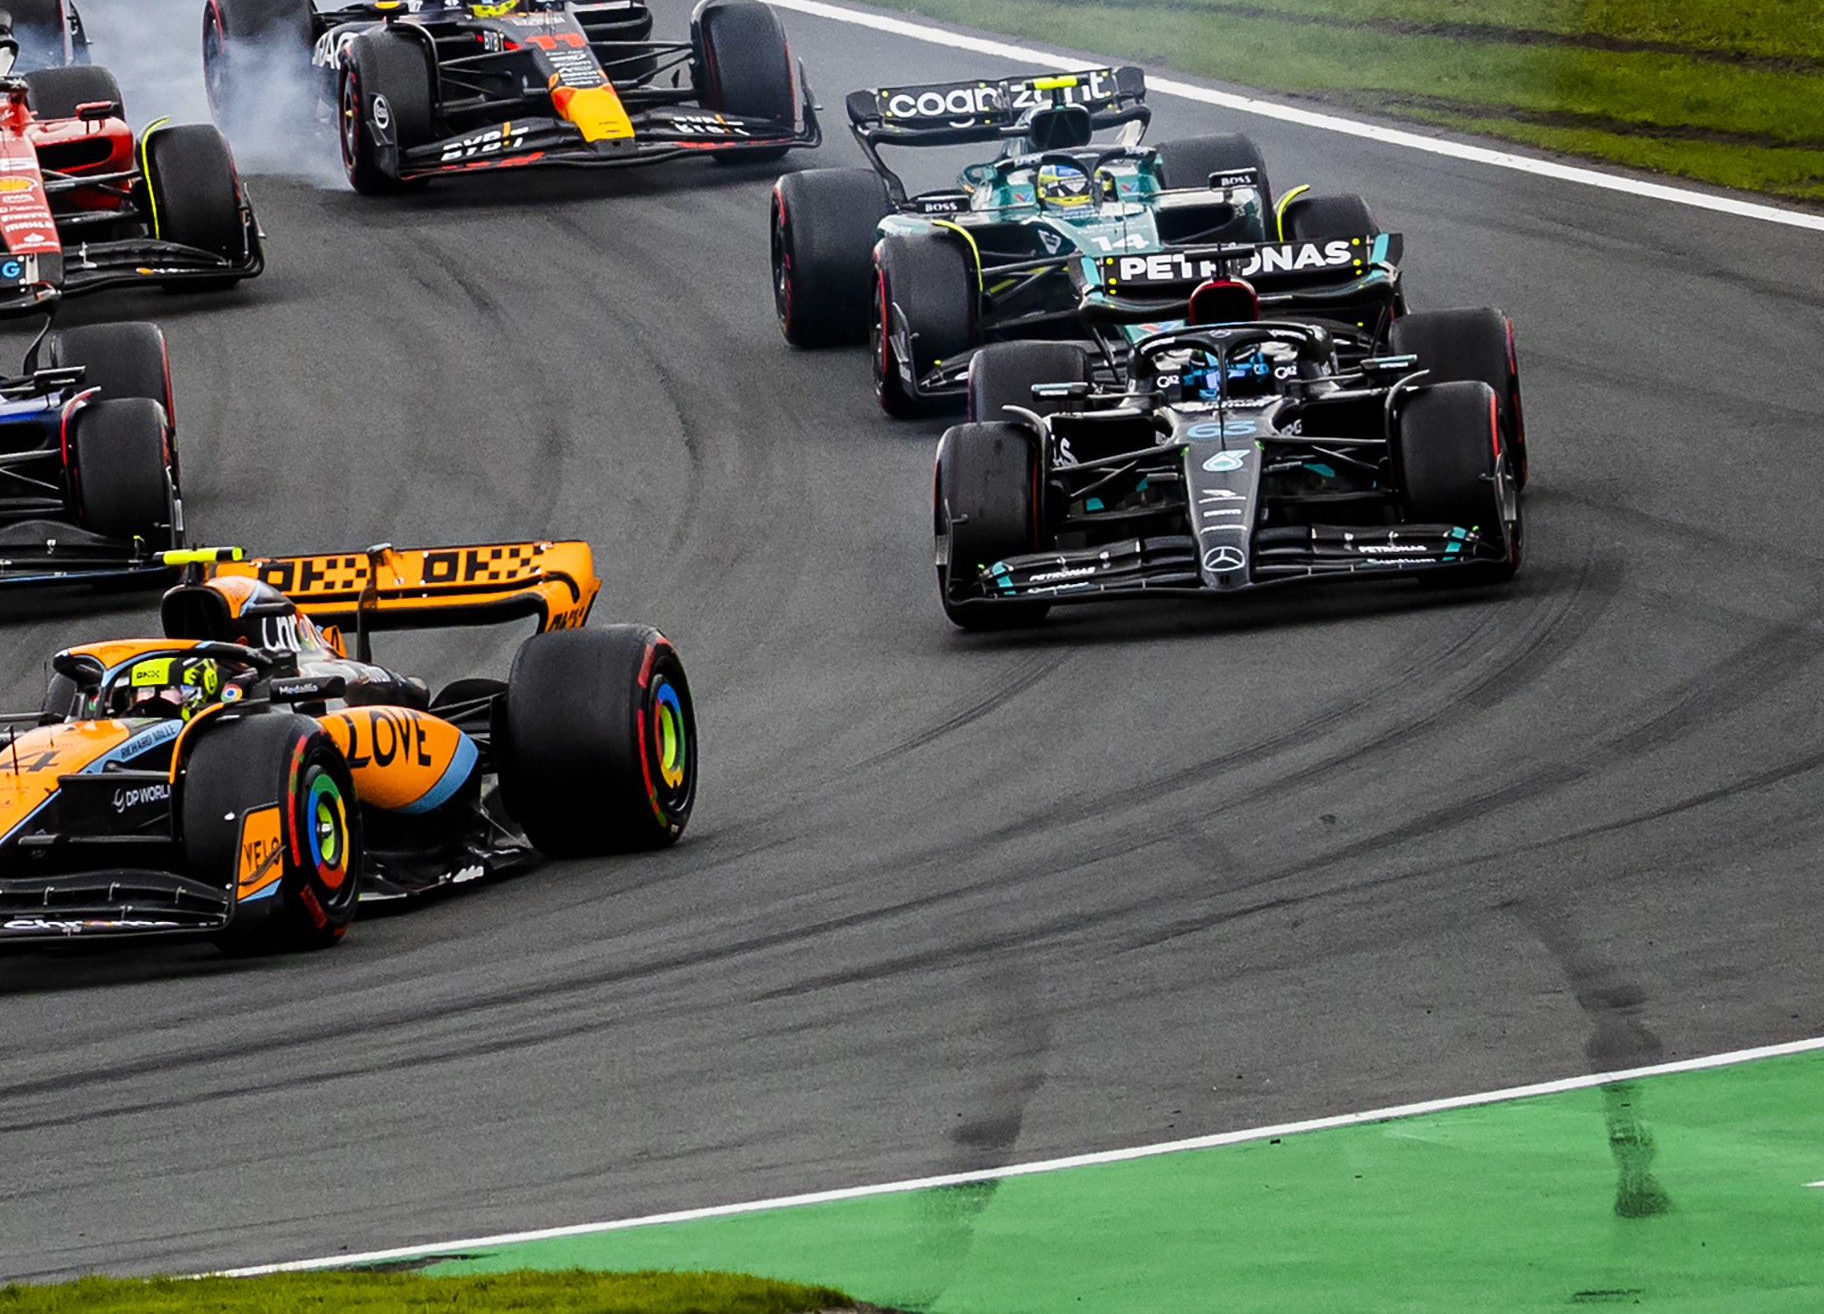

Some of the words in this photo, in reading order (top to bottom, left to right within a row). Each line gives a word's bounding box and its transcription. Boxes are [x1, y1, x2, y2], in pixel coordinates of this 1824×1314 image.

[525, 32, 587, 51] 11
[889, 71, 1107, 129] cognznt
[1221, 175, 1252, 186] BOSS
[925, 202, 958, 213] BOSS
[1091, 233, 1150, 252] 14
[1186, 420, 1257, 439] 63
[119, 733, 153, 760] RICHARD
[347, 709, 432, 768] LOVE
[125, 790, 139, 809] DP
[139, 783, 171, 806] WORL
